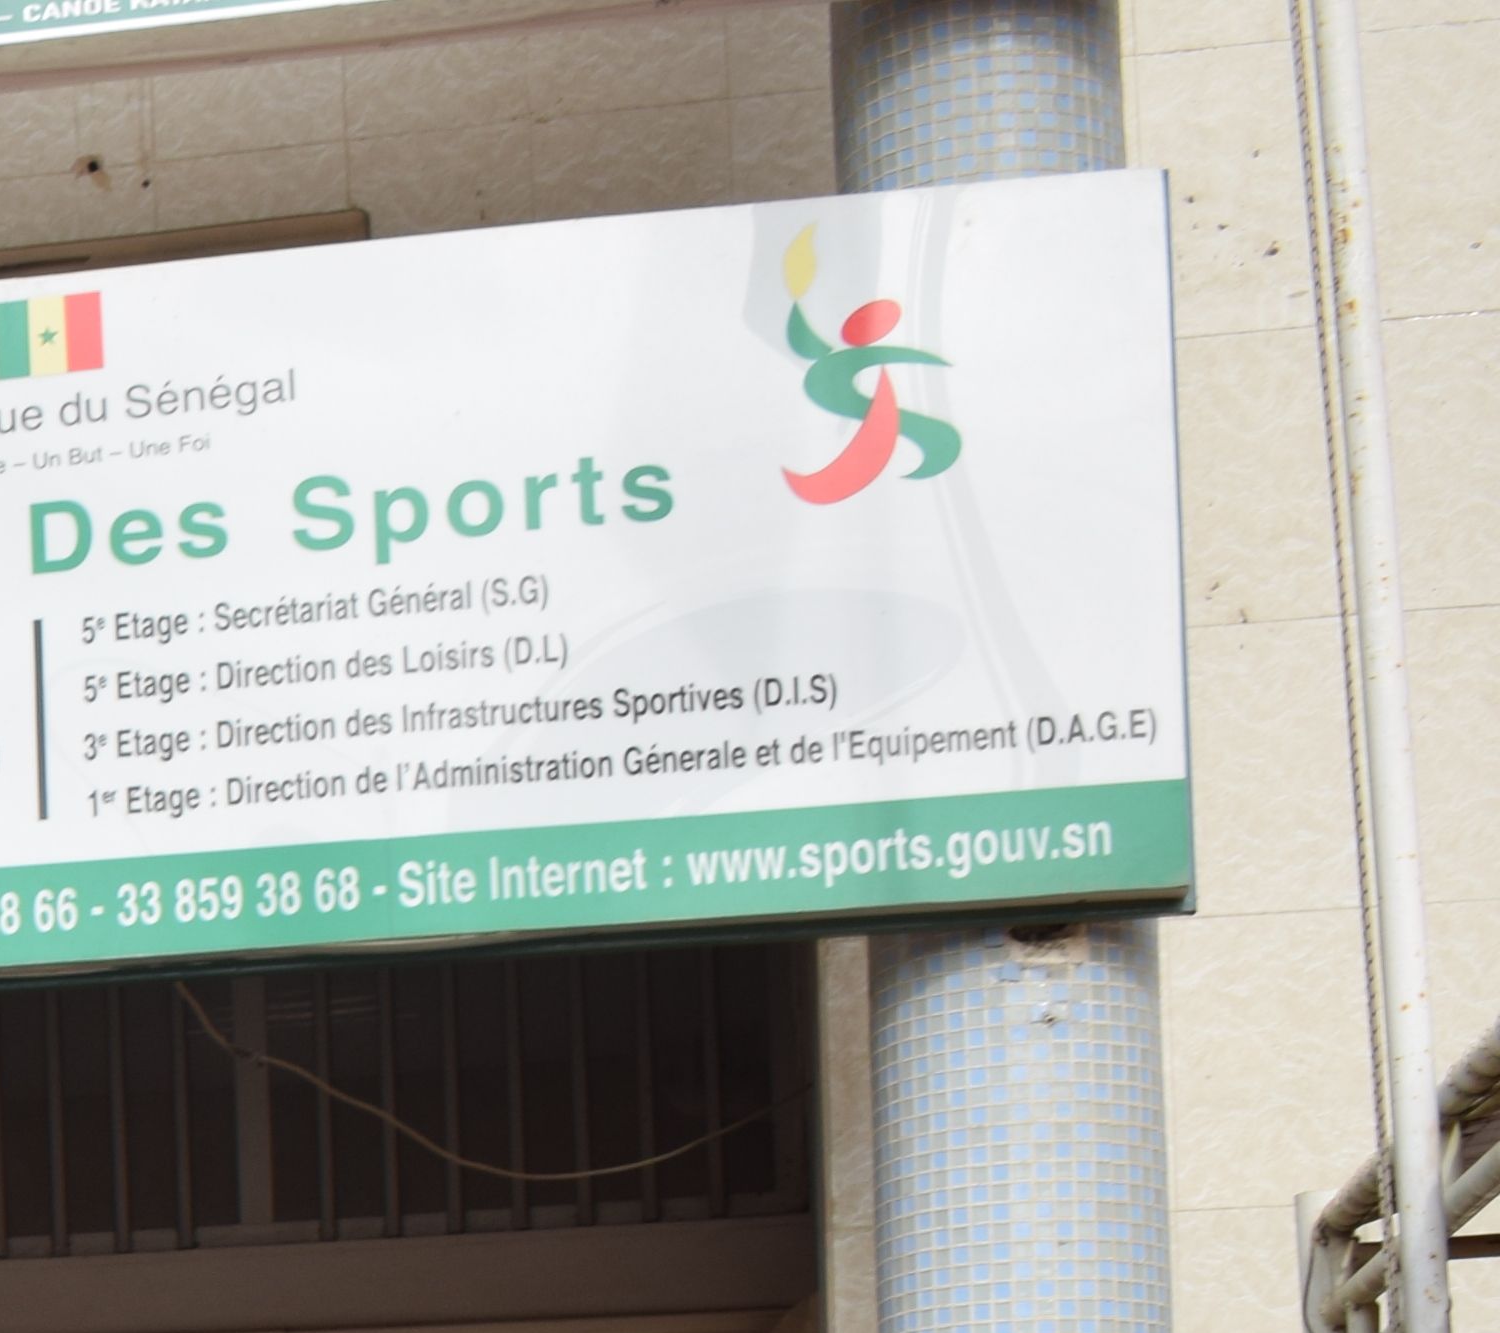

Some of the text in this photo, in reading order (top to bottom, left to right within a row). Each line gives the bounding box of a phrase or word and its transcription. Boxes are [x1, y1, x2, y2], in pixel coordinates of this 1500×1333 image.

[22, 0, 121, 24] CANOE
[58, 391, 108, 428] du
[125, 367, 296, 420] Sénégal
[32, 451, 62, 472] Un
[67, 445, 103, 468] But
[128, 439, 172, 460] Une
[177, 433, 211, 454] Foi
[28, 498, 229, 576] Des
[292, 455, 675, 566] Sports
[114, 610, 189, 646] Etage
[213, 592, 359, 632] Secrétariat
[367, 580, 472, 619] Général
[481, 574, 549, 613] (S.G)
[116, 669, 191, 706] Etage
[216, 653, 336, 691] Direction
[345, 648, 393, 680] des
[402, 639, 495, 675] Loisirs
[504, 632, 569, 672] (D.L)
[116, 728, 191, 763] Etage
[216, 713, 336, 750] Direction
[345, 708, 393, 739] des
[402, 695, 604, 733] Infrastructures
[612, 682, 745, 725] Sportives
[753, 672, 838, 715] (D.I.S)
[126, 784, 201, 820] Etage
[226, 769, 346, 807] Direction
[355, 765, 389, 796] de
[754, 737, 781, 768] et
[789, 734, 824, 766] de
[1026, 707, 1157, 753] (D.A.G.E)
[33, 886, 79, 934] 66
[117, 880, 163, 928] 33
[174, 874, 244, 924] 859
[256, 870, 302, 918] 38
[315, 865, 361, 913] 68
[398, 859, 477, 909] Site
[489, 847, 648, 901] Internet
[686, 820, 1112, 889] www.sports.gouv.sn
